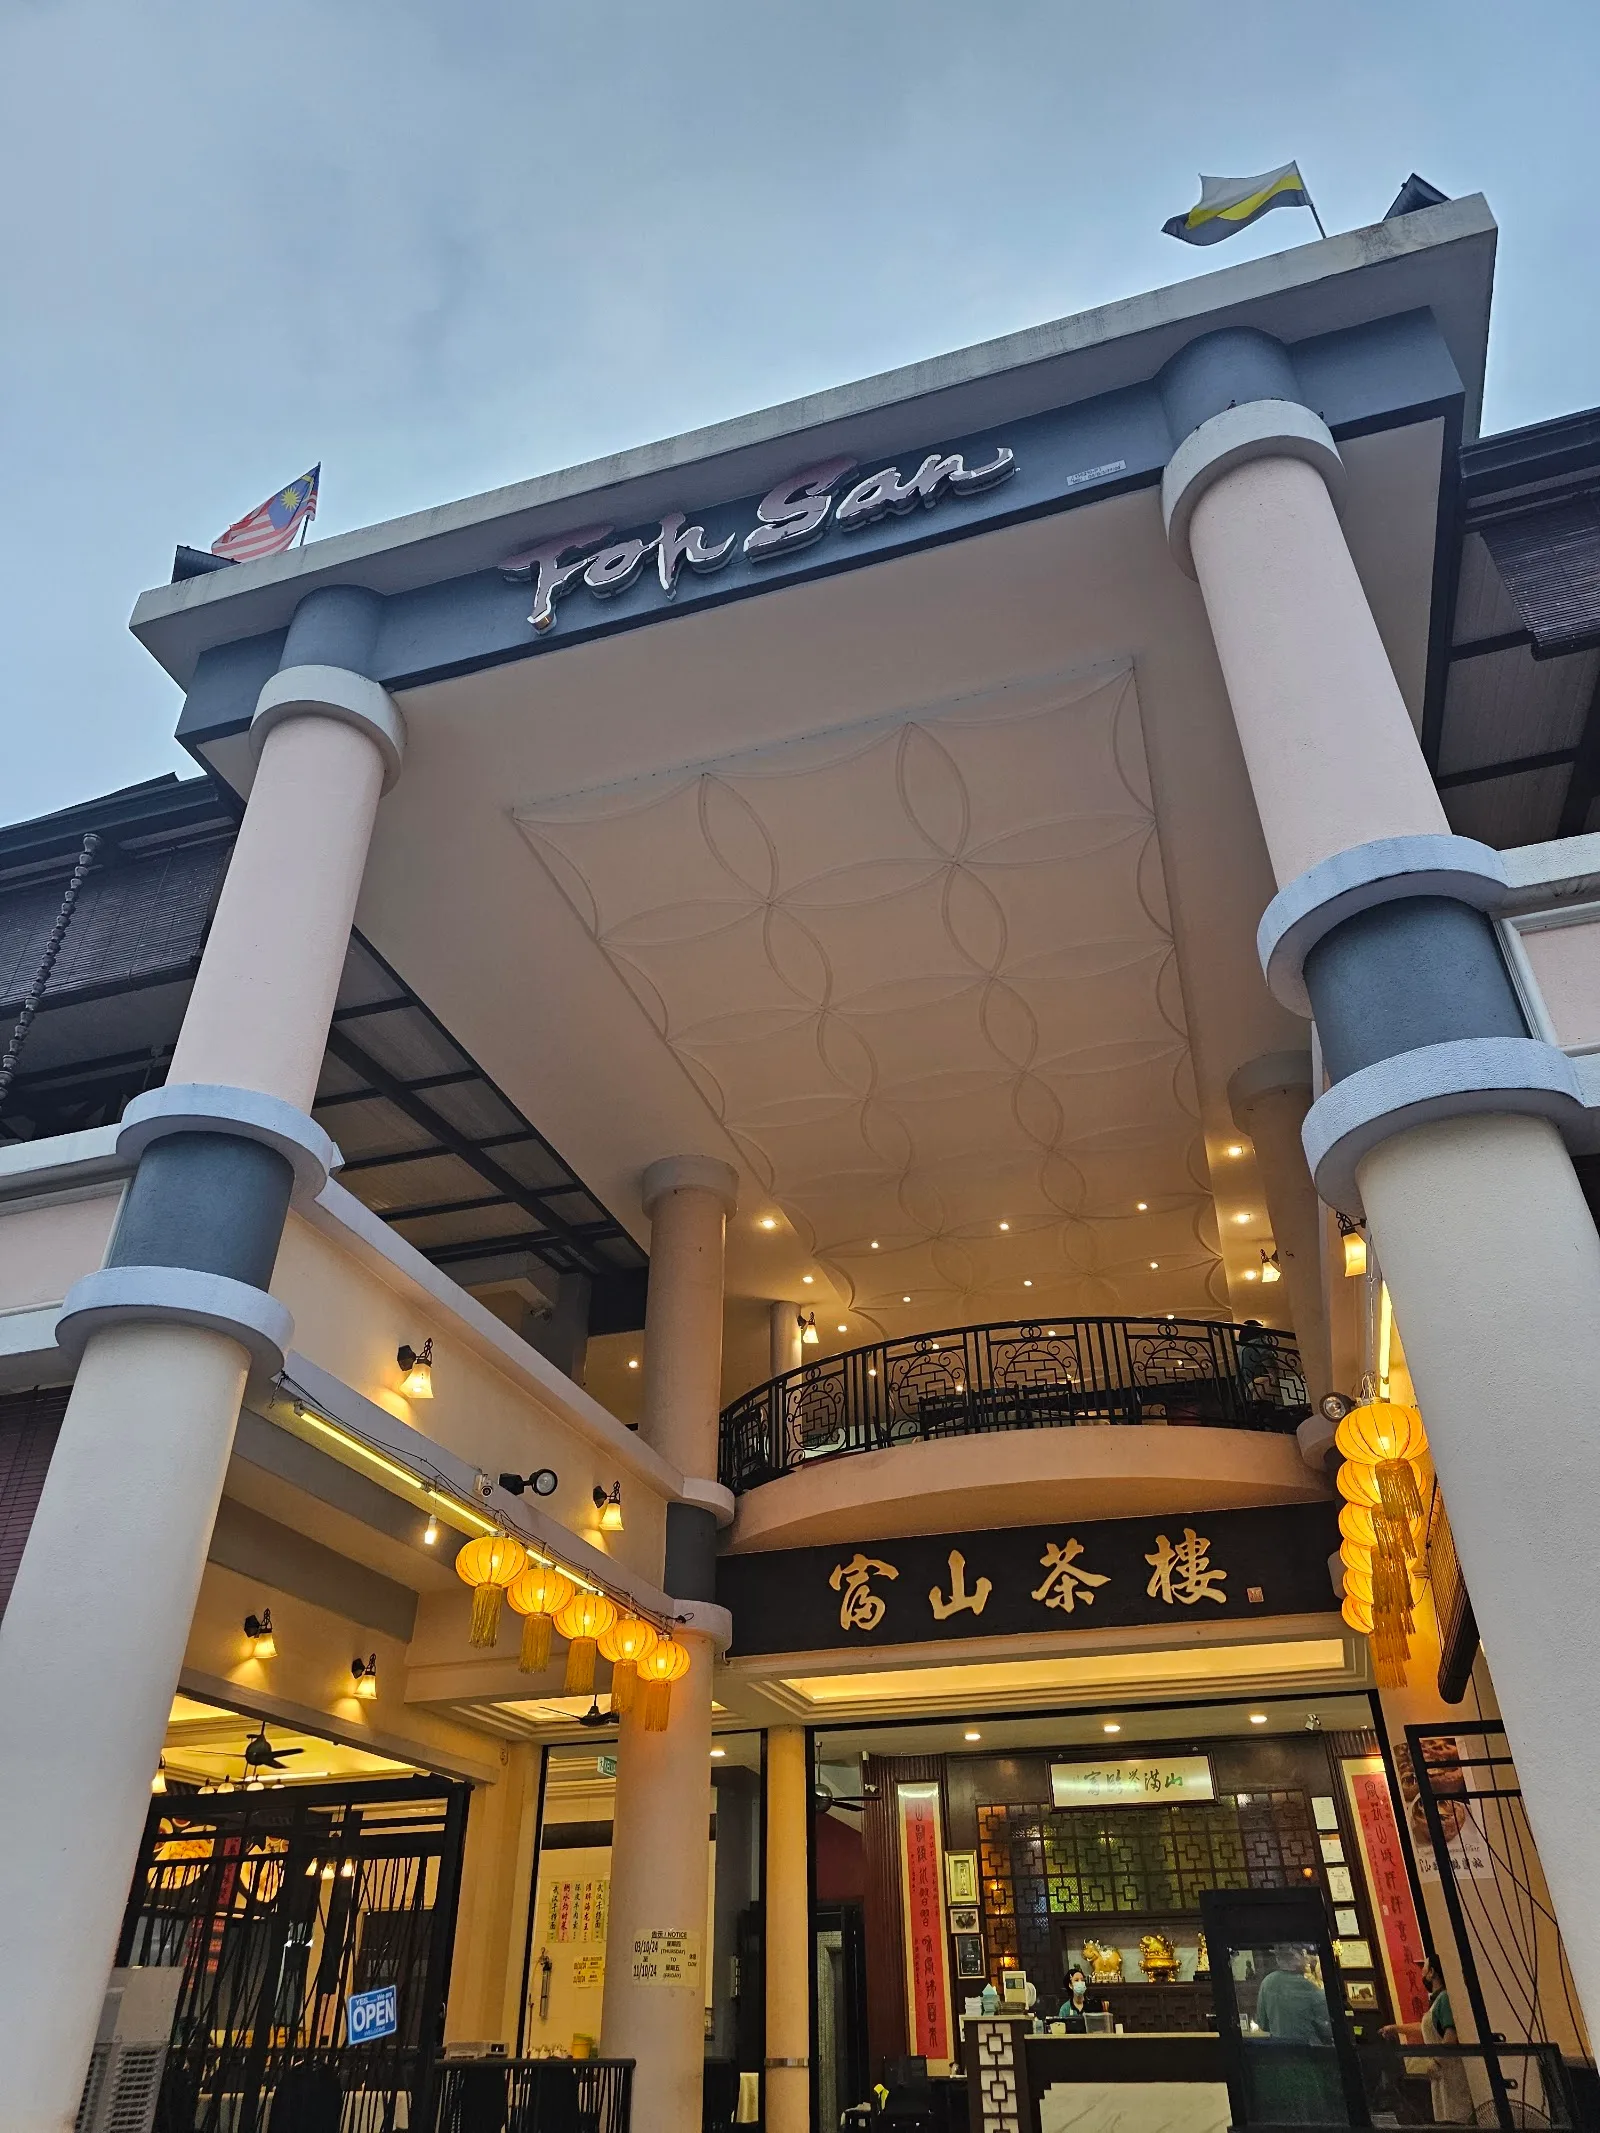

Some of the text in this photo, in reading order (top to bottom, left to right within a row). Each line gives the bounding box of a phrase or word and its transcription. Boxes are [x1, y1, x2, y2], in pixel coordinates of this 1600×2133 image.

[499, 447, 1016, 634] Foh San
[828, 1528, 1227, 1631] 富山茶樓
[634, 1940, 658, 1955] 03/10/24
[633, 1963, 657, 1979] 11/10/24
[353, 1997, 395, 2033] OPEN
